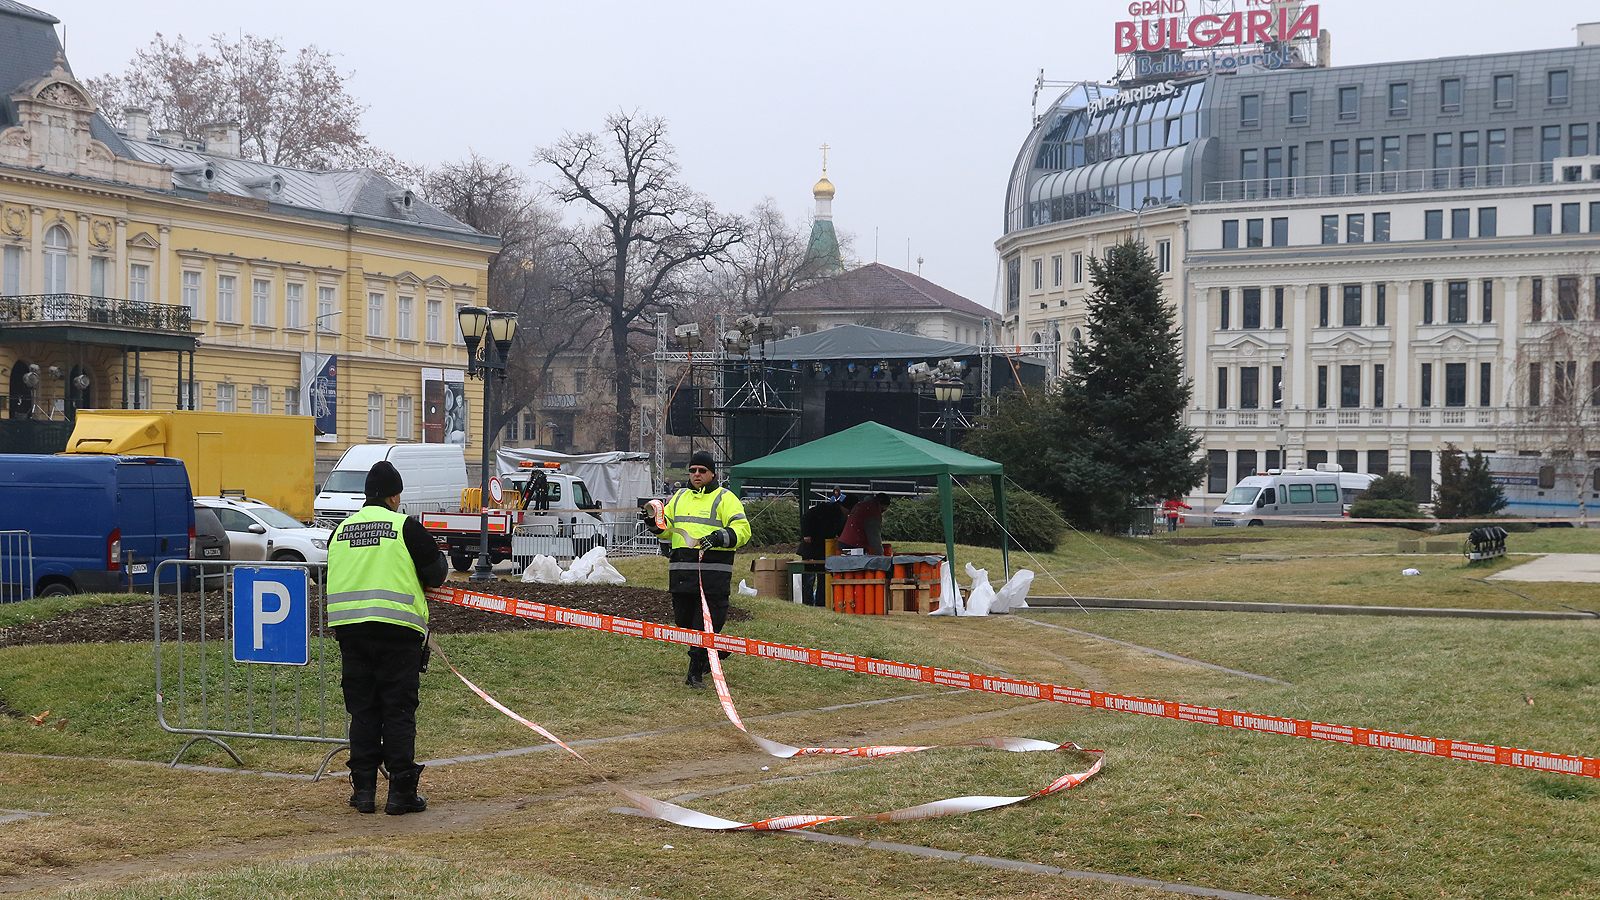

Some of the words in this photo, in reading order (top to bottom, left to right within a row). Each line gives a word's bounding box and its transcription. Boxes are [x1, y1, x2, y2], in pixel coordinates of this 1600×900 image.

[1128, 0, 1186, 16] GRAND
[1115, 5, 1319, 54] BULGARIA
[1138, 45, 1293, 75] Balkantourist
[1087, 96, 1113, 115] BNP
[1114, 80, 1175, 107] PARIBAS
[337, 530, 397, 541] СПАСИТЕЛНО
[343, 522, 391, 533] АВАРИЙНО
[350, 537, 379, 547] ЗВЕНО
[462, 594, 468, 605] НЕ
[253, 581, 291, 649] P
[556, 610, 562, 621] НЕ
[563, 612, 602, 628] ПРЕМИНАВАЙ!
[654, 627, 661, 638] НЕ
[662, 629, 702, 645] ПРЕМИНАВАЙ!
[758, 645, 766, 656] НЕ
[767, 646, 809, 662] ПРЕМИНАВАЙ!
[868, 661, 876, 673] НЕ
[877, 662, 921, 679] ПРЕМИНАВАЙ!
[983, 679, 991, 690] НЕ
[992, 679, 1040, 697] ПРЕМИНАВАЙ!
[1105, 696, 1114, 708] НЕ
[1115, 698, 1165, 715] ПРЕМИНАВАЙ!
[1233, 715, 1243, 727] НЕ
[1244, 716, 1296, 734] ПРЕМИНАВАЙ!
[1369, 733, 1378, 746] НЕ
[1380, 735, 1435, 753] ПРЕМИНАВАЙ!
[1451, 742, 1472, 751] ДИРЕКЦИЯ
[1474, 745, 1494, 753] АВАРИЙНА
[1471, 753, 1495, 761] ПРЕВЕНЦИЯ
[1512, 752, 1522, 765] НЕ
[1524, 754, 1583, 773] ПРЕМИНАВАЙ!
